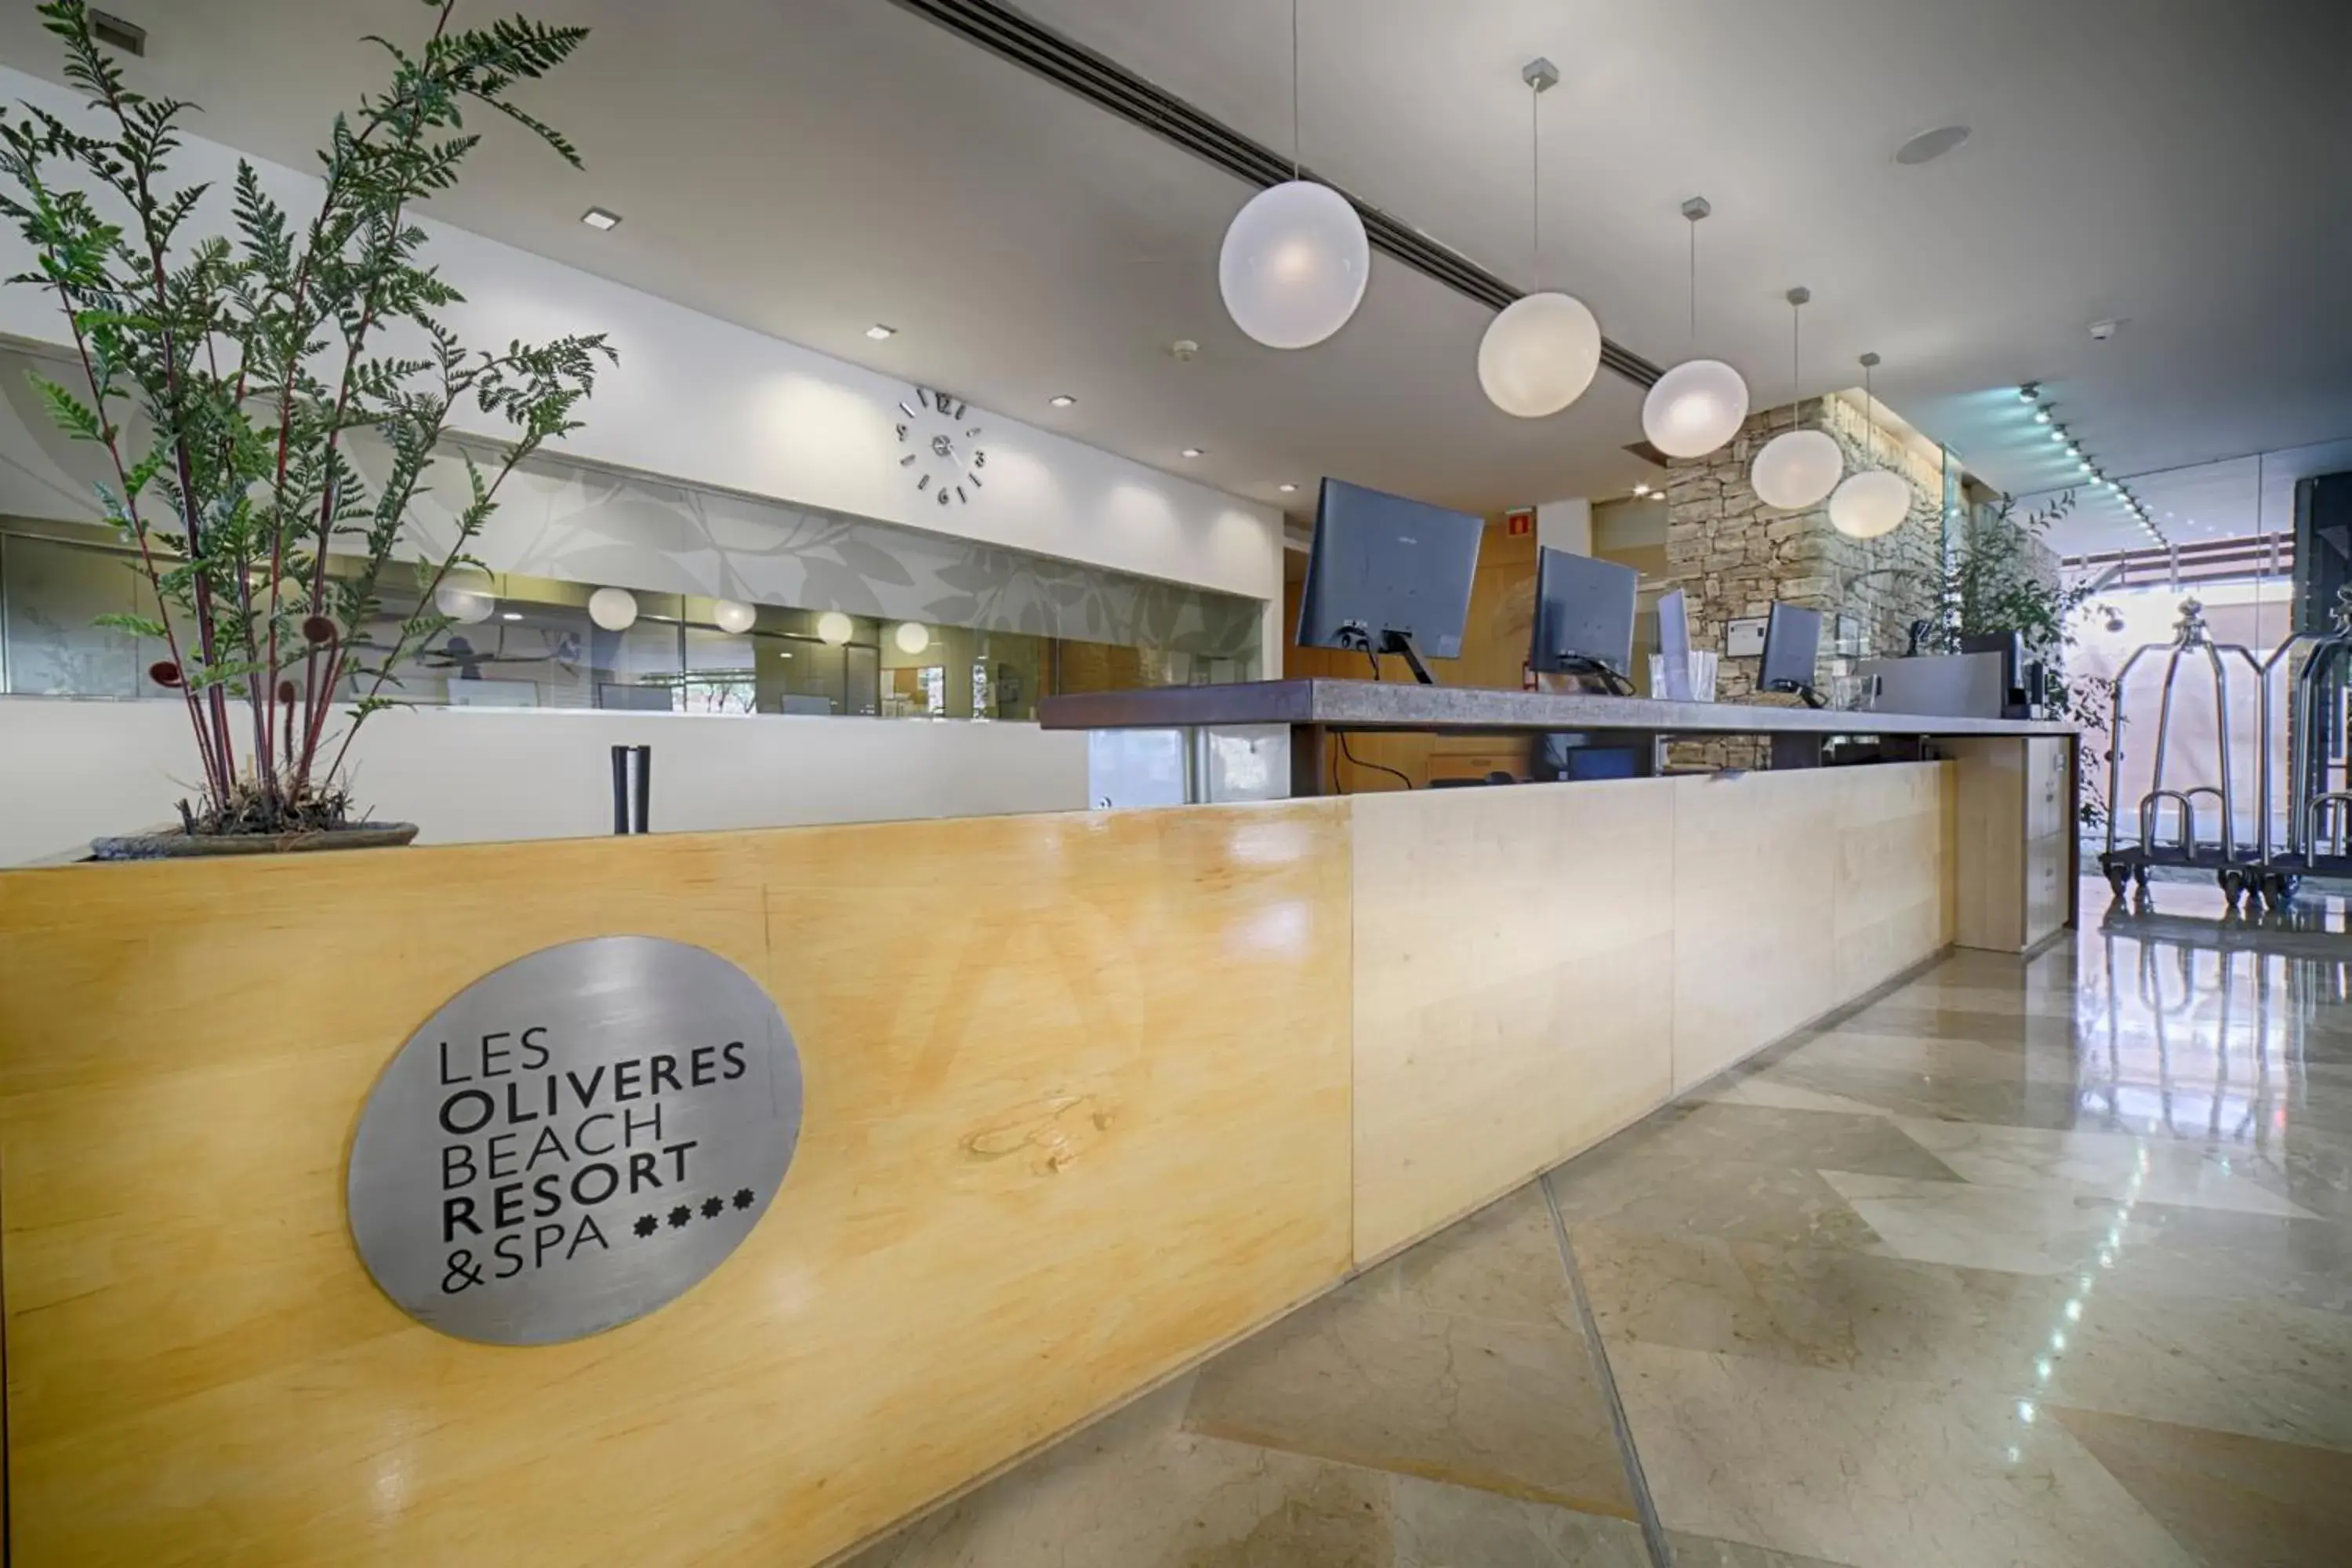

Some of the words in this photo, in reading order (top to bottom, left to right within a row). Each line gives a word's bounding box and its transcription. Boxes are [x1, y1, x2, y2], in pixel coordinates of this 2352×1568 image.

[935, 392, 953, 416] 12
[975, 450, 985, 468] 3
[938, 487, 949, 505] 6
[440, 1026, 550, 1086] LES
[438, 1041, 746, 1135] OLIVERES
[442, 1102, 662, 1191] BEACH
[442, 1141, 698, 1243] RESORT
